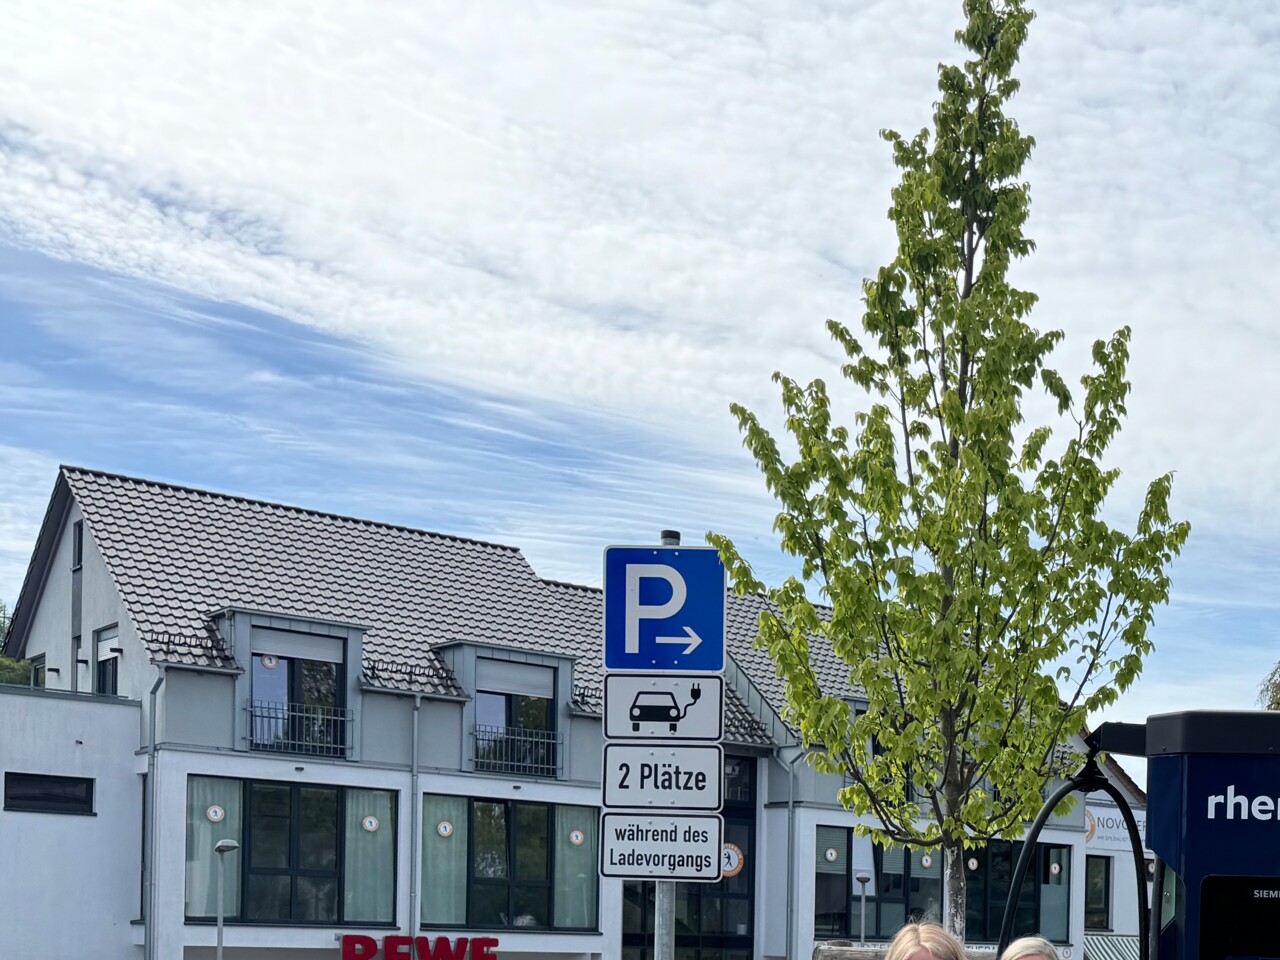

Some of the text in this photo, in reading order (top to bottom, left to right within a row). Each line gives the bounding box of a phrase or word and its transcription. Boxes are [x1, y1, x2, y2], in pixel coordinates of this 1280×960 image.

[625, 563, 687, 654] P
[618, 762, 706, 791] 2 Plätze
[614, 825, 708, 843] während des
[609, 848, 711, 872] Ladevorgangs
